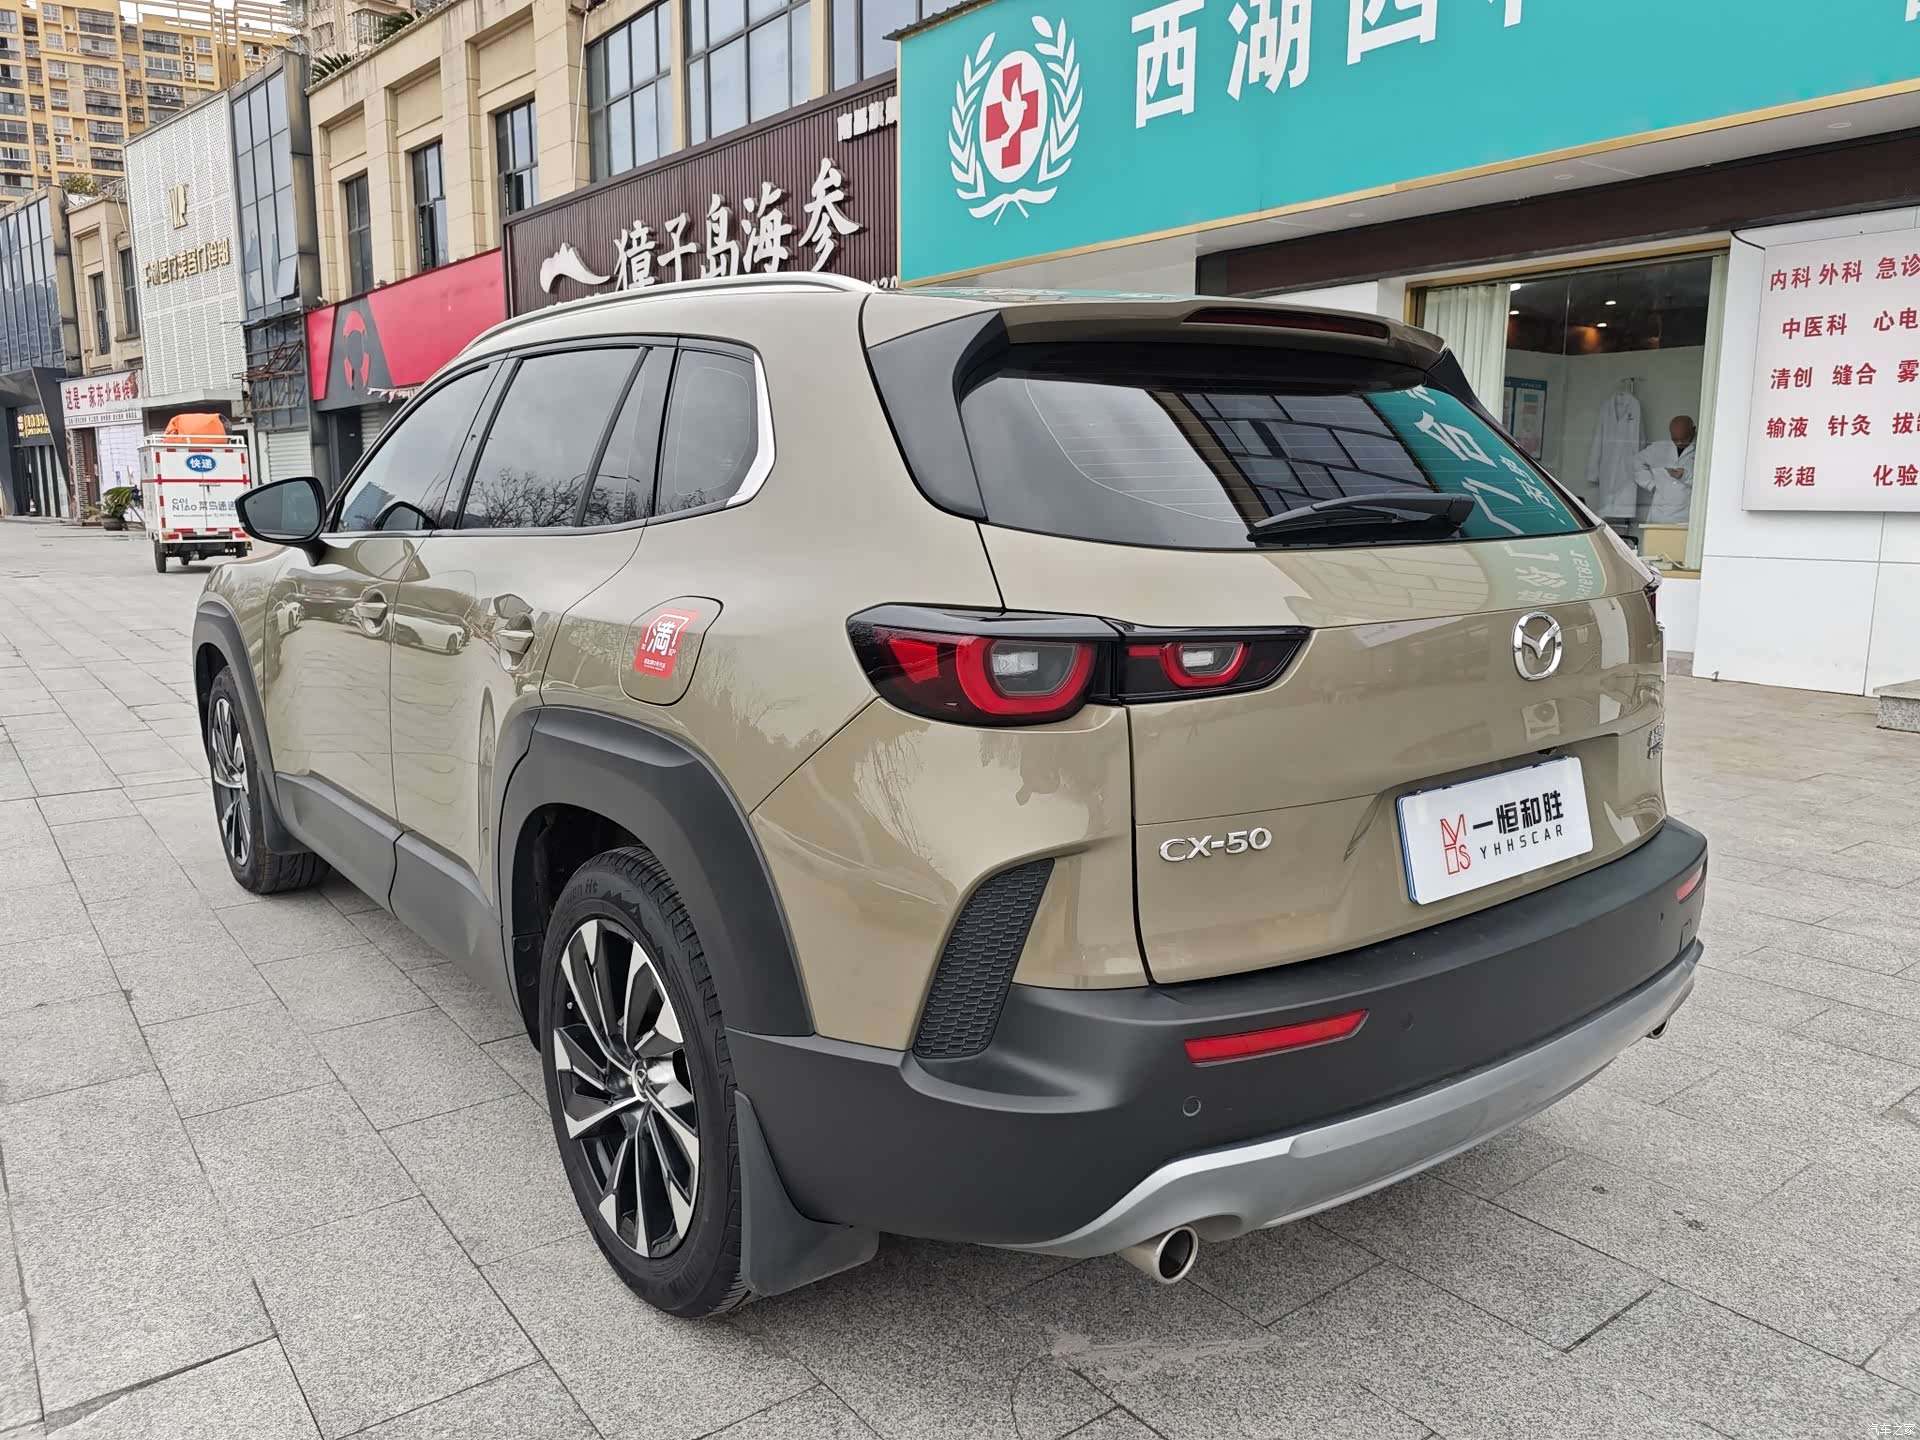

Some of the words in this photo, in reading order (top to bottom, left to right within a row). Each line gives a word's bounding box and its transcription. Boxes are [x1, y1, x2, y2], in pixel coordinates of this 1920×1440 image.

[614, 158, 861, 292] 獐子岛海参
[1770, 265, 1811, 291] 内科
[1819, 260, 1863, 285] 外科
[1876, 253, 1920, 279] 急诊
[1782, 312, 1847, 339] 中医科
[1873, 307, 1920, 331] 心电
[1770, 366, 1813, 389] 清创
[1832, 362, 1877, 385] 缝合
[1897, 359, 1920, 383] 雾
[1766, 417, 1809, 438] 输液
[1828, 414, 1871, 436] 针灸
[1892, 412, 1920, 434] 拔
[189, 458, 213, 469] 快递
[1774, 465, 1815, 487] 彩超
[1873, 464, 1920, 486] 化验
[647, 620, 677, 656] 满
[1473, 790, 1564, 835] 一恒和胜
[1159, 827, 1273, 862] CX-50
[1479, 824, 1563, 860] YHHSCAR
